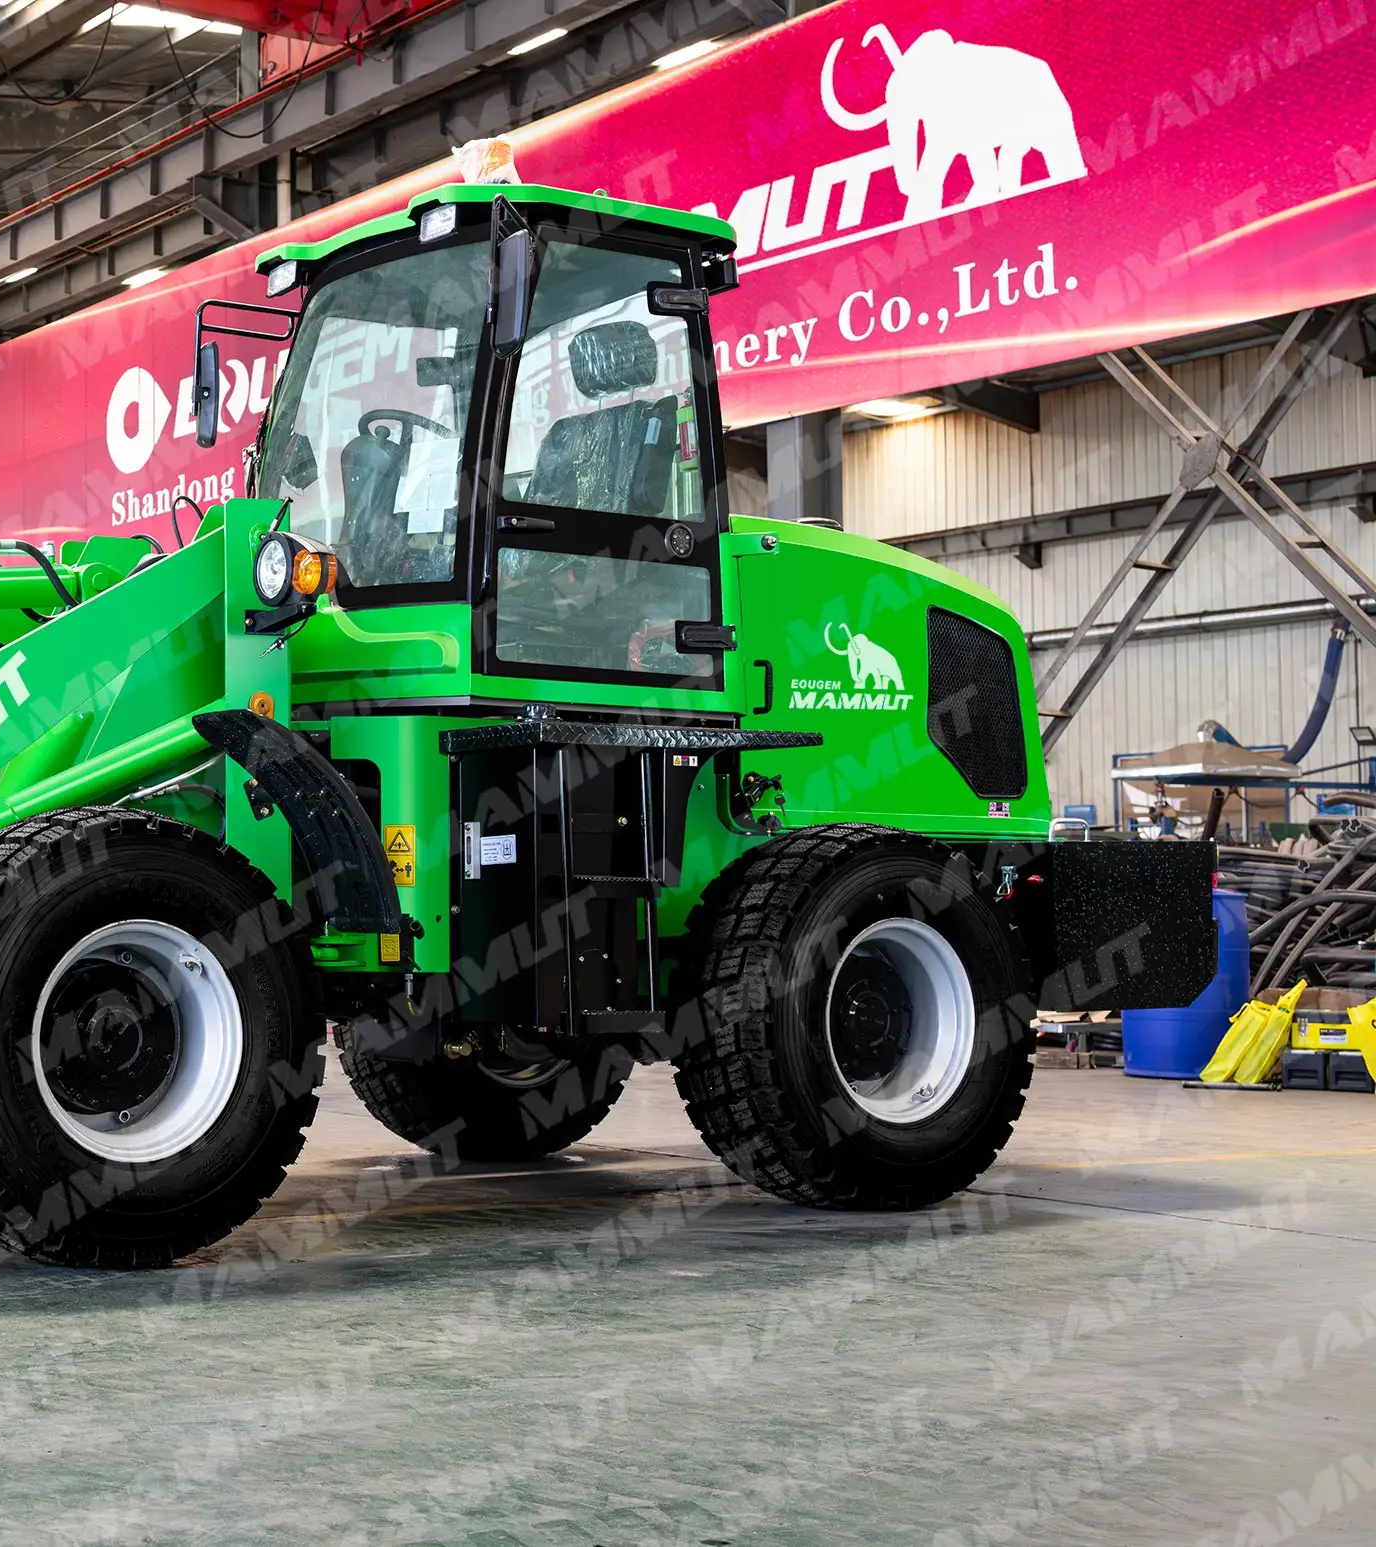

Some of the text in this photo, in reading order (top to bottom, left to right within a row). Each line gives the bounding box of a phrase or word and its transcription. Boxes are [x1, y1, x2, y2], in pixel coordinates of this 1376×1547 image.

[112, 466, 236, 527] Shandong
[838, 242, 1079, 342] Co.,Ltd.
[790, 679, 842, 690] EOUGEM
[788, 691, 914, 710] MAMMUT
